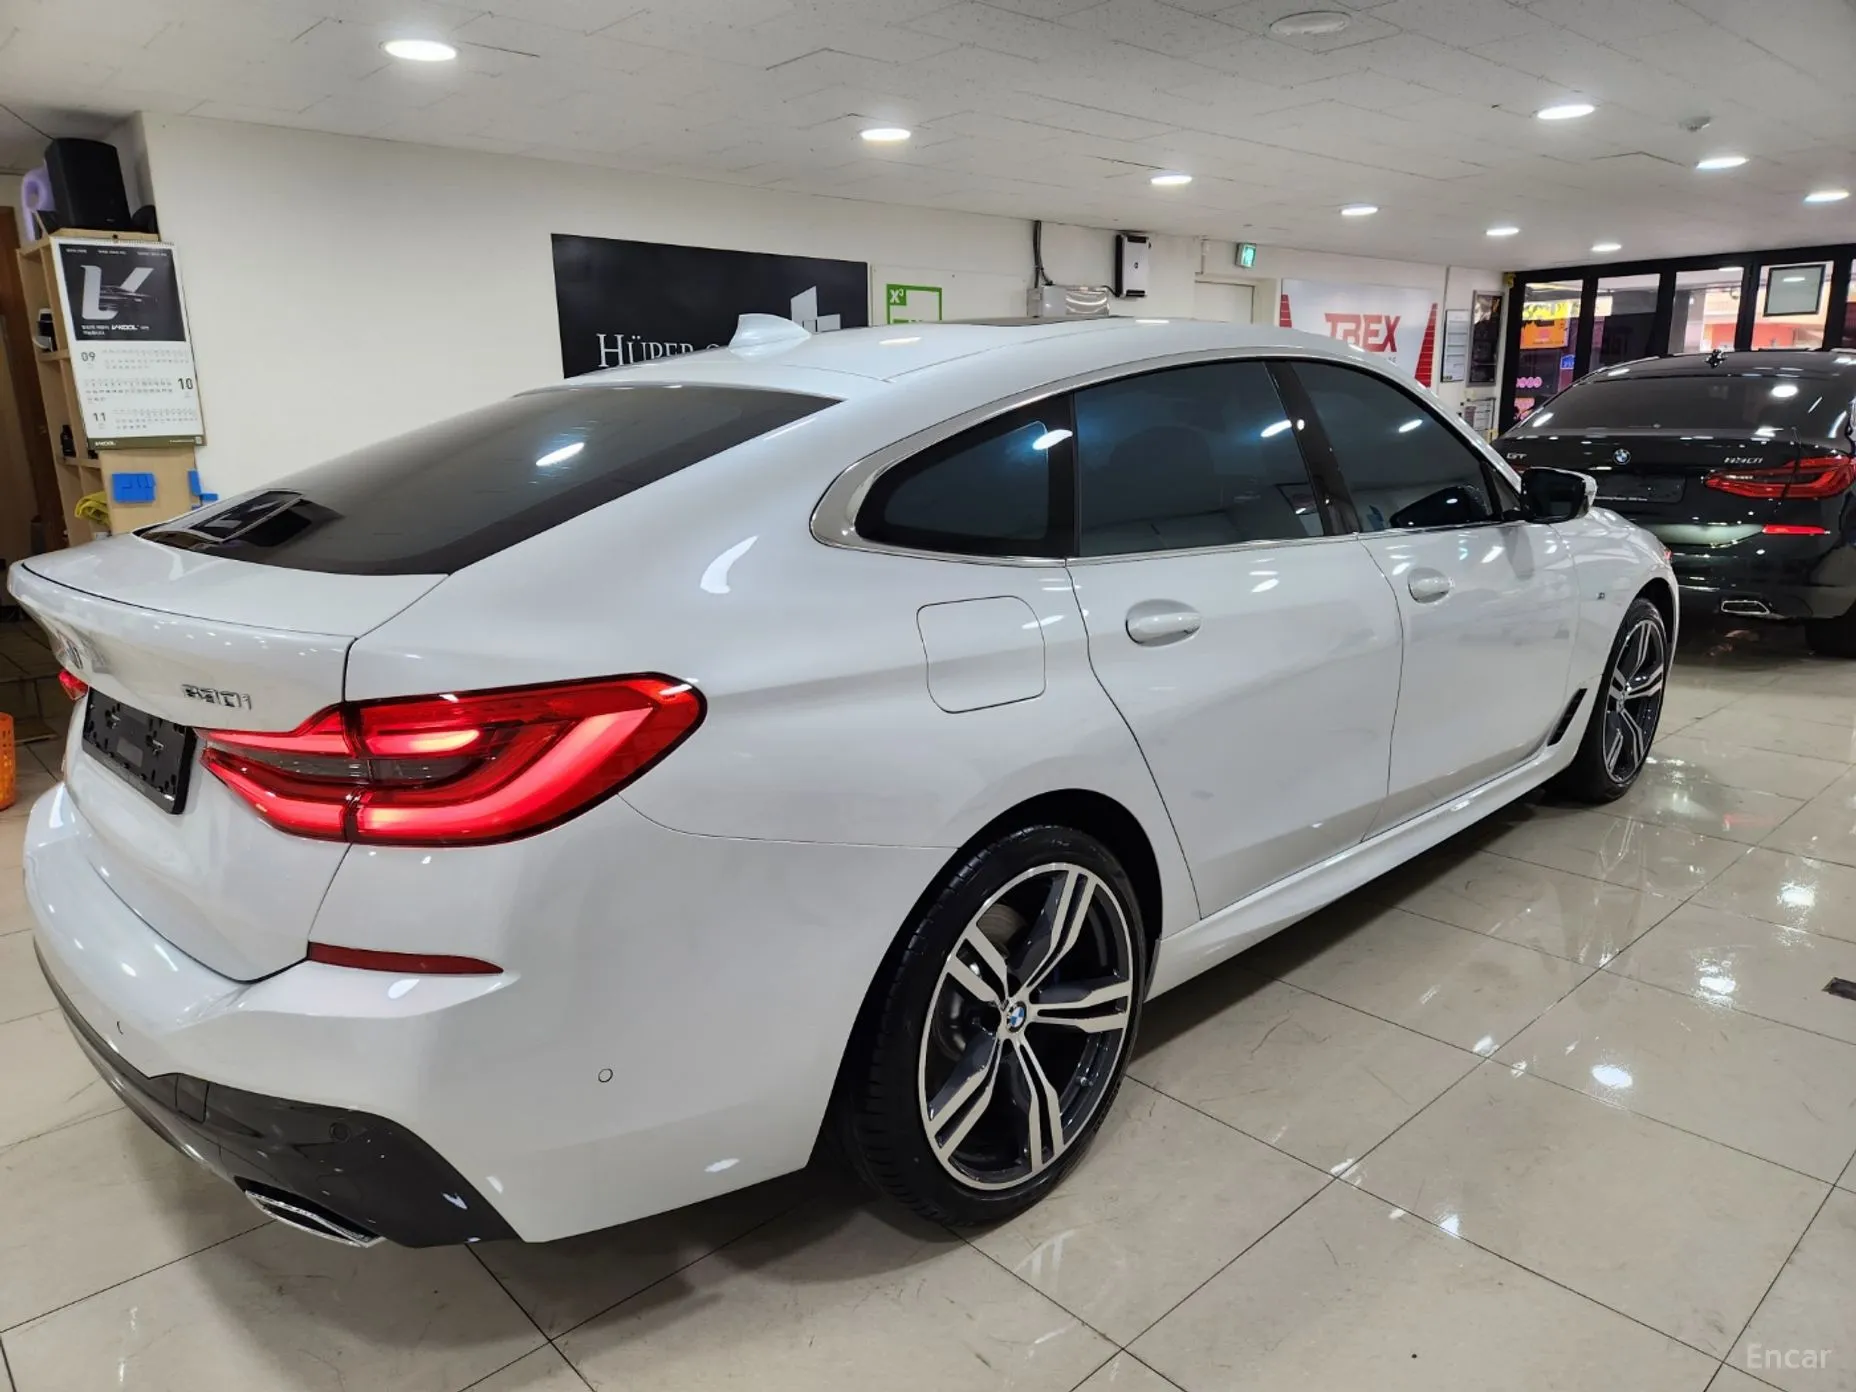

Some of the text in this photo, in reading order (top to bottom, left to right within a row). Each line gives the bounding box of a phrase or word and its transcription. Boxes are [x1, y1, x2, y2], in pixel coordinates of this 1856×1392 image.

[1324, 313, 1401, 352] TREX
[81, 351, 96, 361] 09
[177, 378, 194, 390] 10
[93, 412, 106, 421] 11
